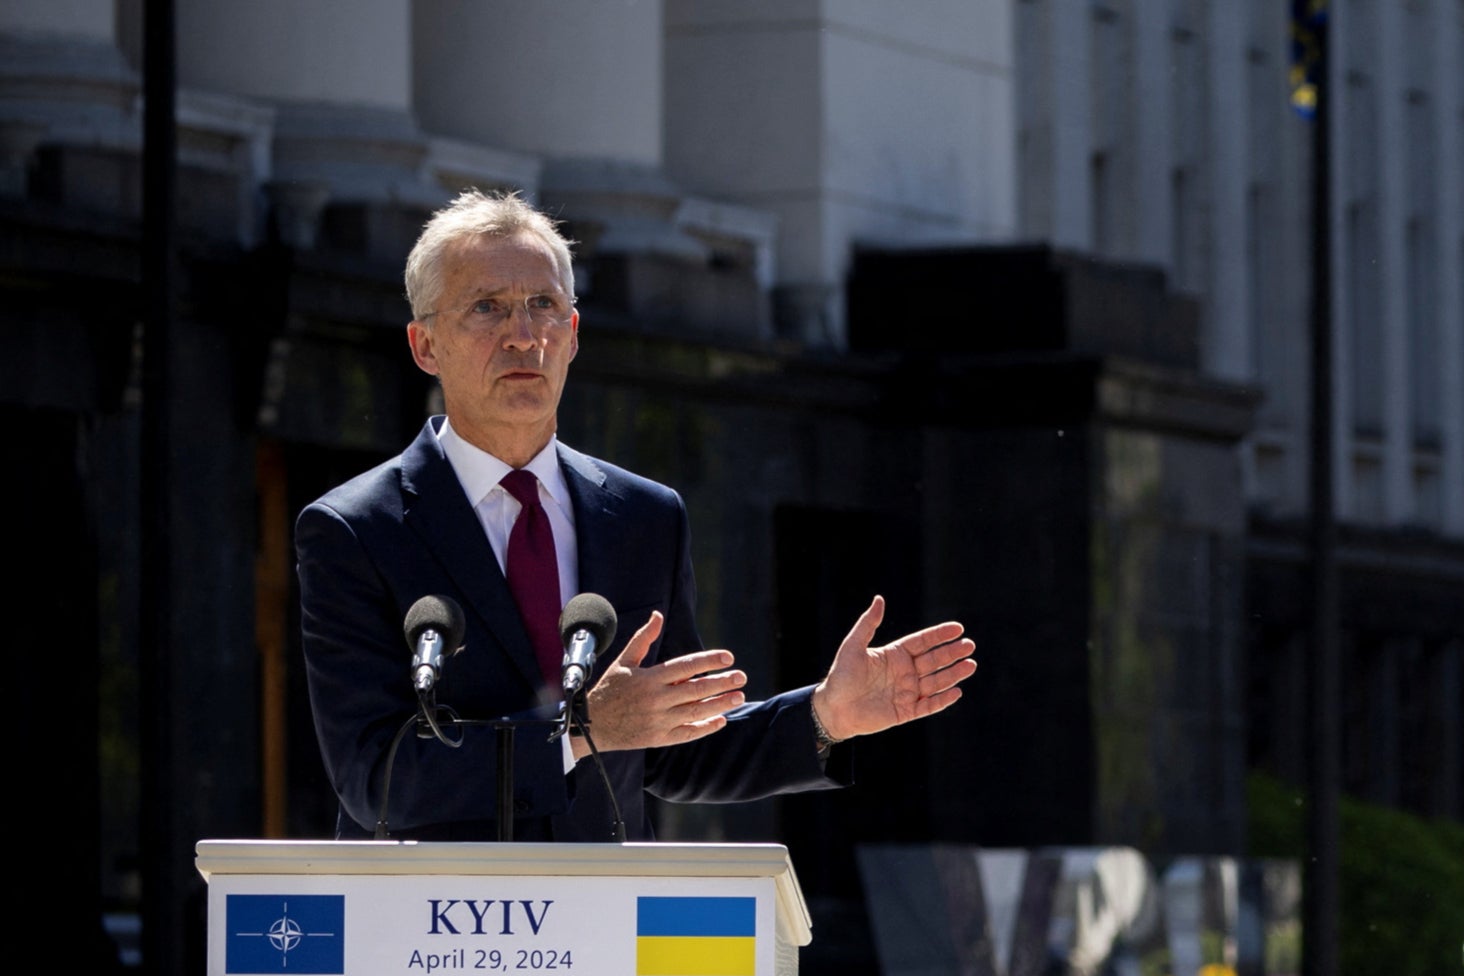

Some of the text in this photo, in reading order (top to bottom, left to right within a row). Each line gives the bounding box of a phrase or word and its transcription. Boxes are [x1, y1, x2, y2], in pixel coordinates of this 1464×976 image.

[427, 899, 555, 936] KYIV
[408, 948, 573, 974] April 29, 2024
